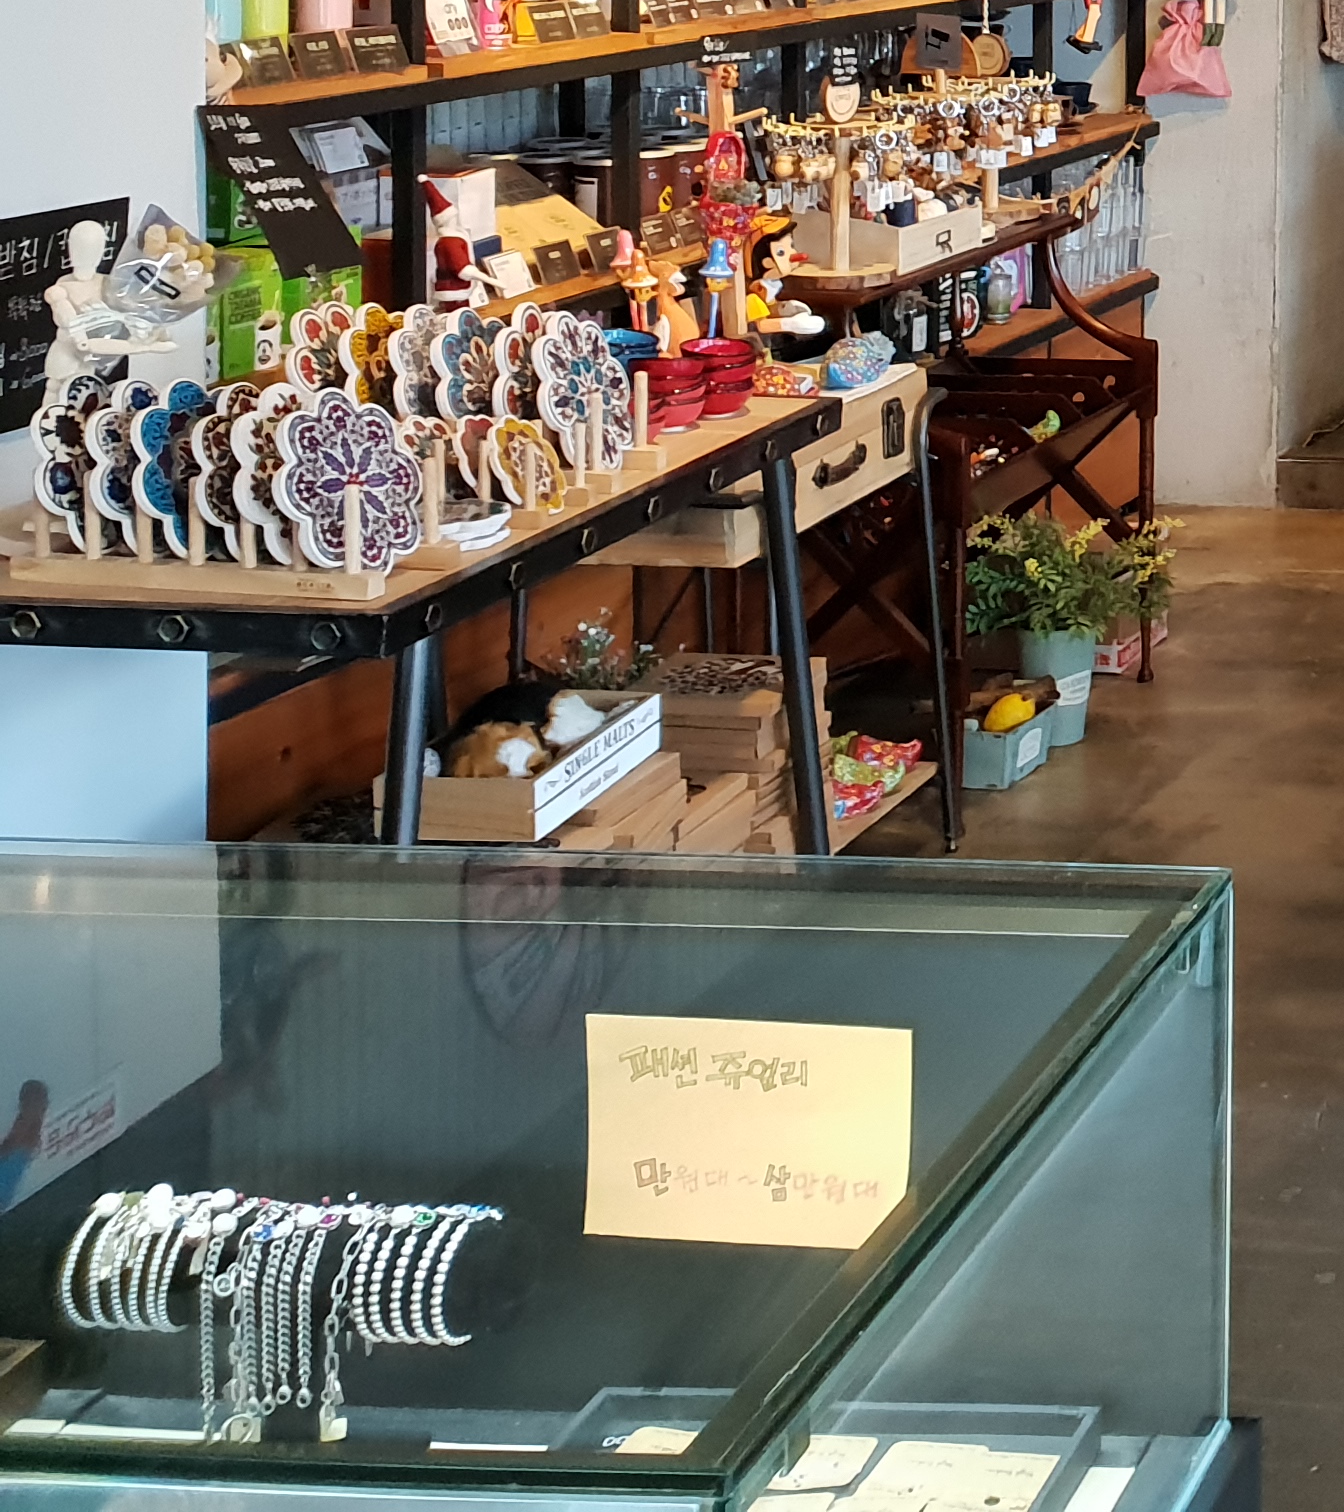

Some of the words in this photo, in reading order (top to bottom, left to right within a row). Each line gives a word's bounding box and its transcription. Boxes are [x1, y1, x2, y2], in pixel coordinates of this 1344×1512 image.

[563, 739, 600, 784] SINGLE
[602, 717, 636, 754] MALTS
[618, 1044, 699, 1089] 패션
[704, 1050, 809, 1093] 쥬얼리
